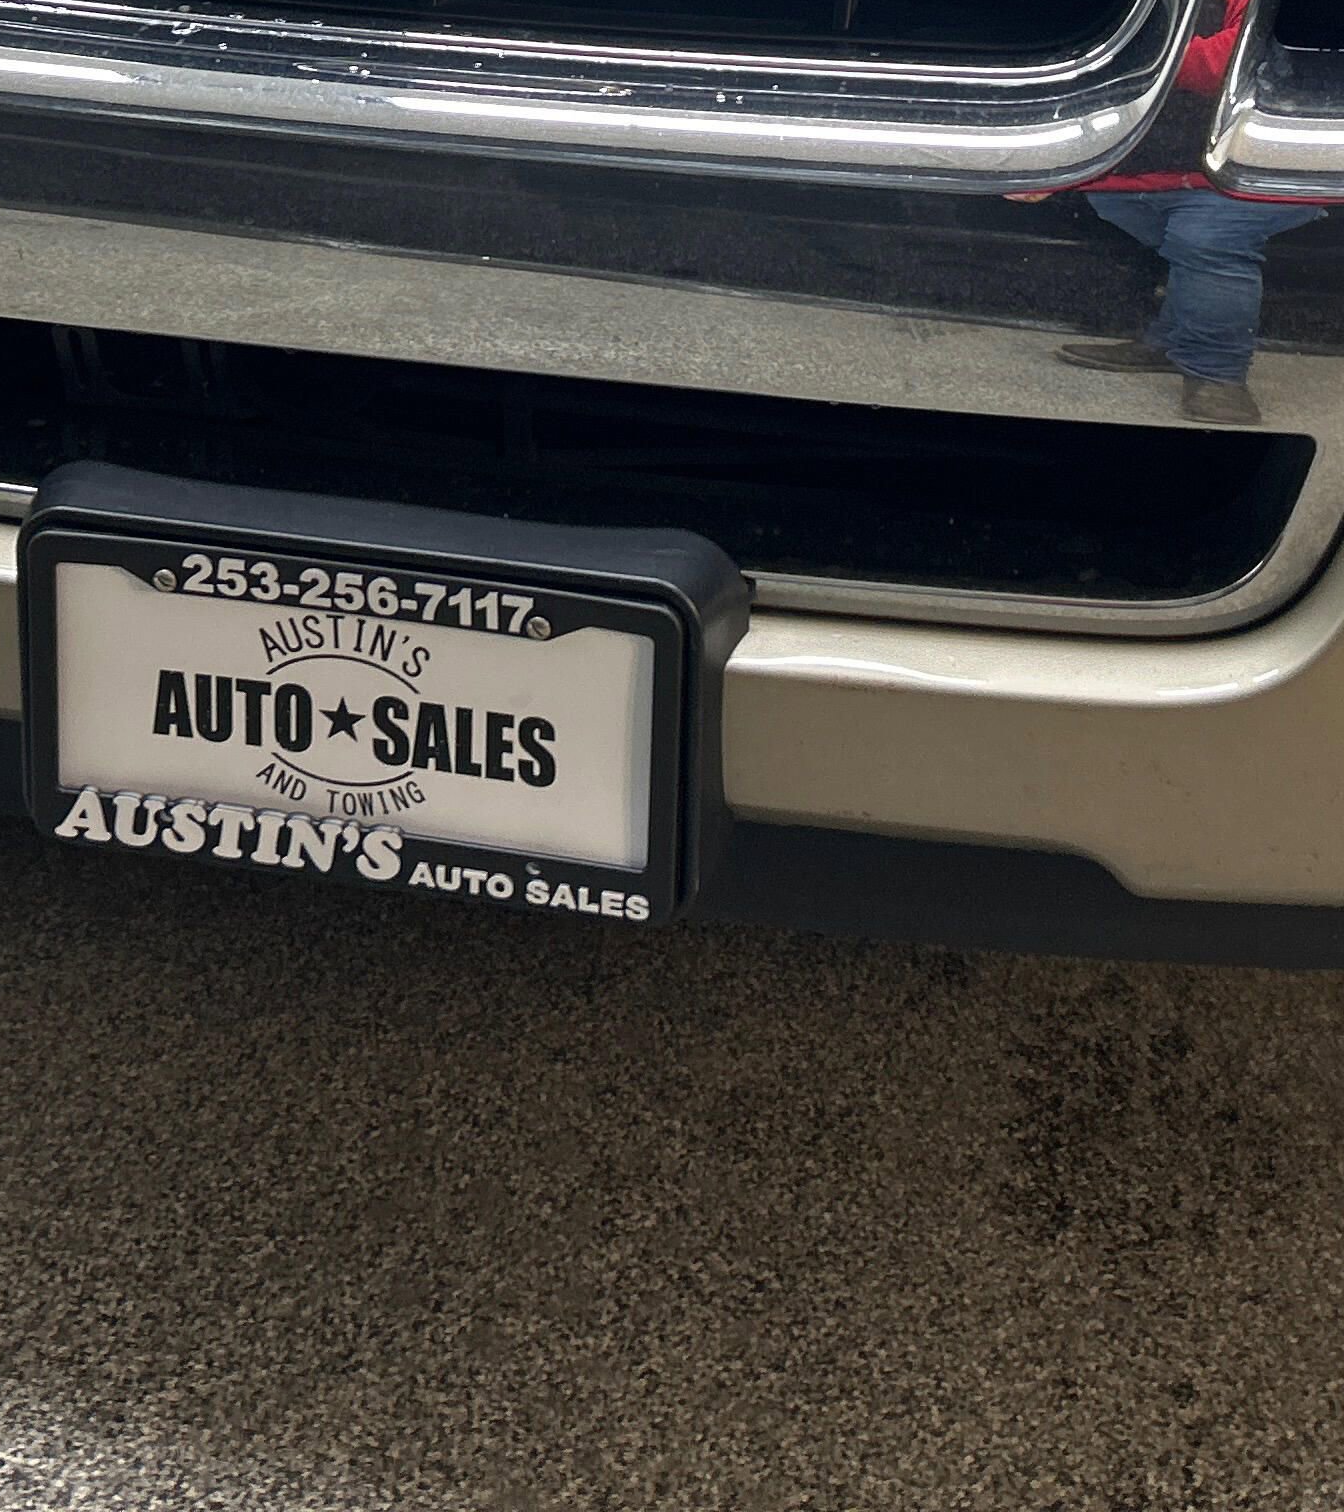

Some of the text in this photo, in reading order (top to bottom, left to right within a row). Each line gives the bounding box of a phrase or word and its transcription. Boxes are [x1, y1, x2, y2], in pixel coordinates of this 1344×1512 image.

[181, 553, 535, 635] 253-256-7117
[258, 614, 431, 679] AUSTIN'S
[152, 669, 556, 788] AUTO SALES
[256, 762, 427, 818] AND TOWING
[55, 786, 650, 921] AUSTIN'S AUTO SALES
